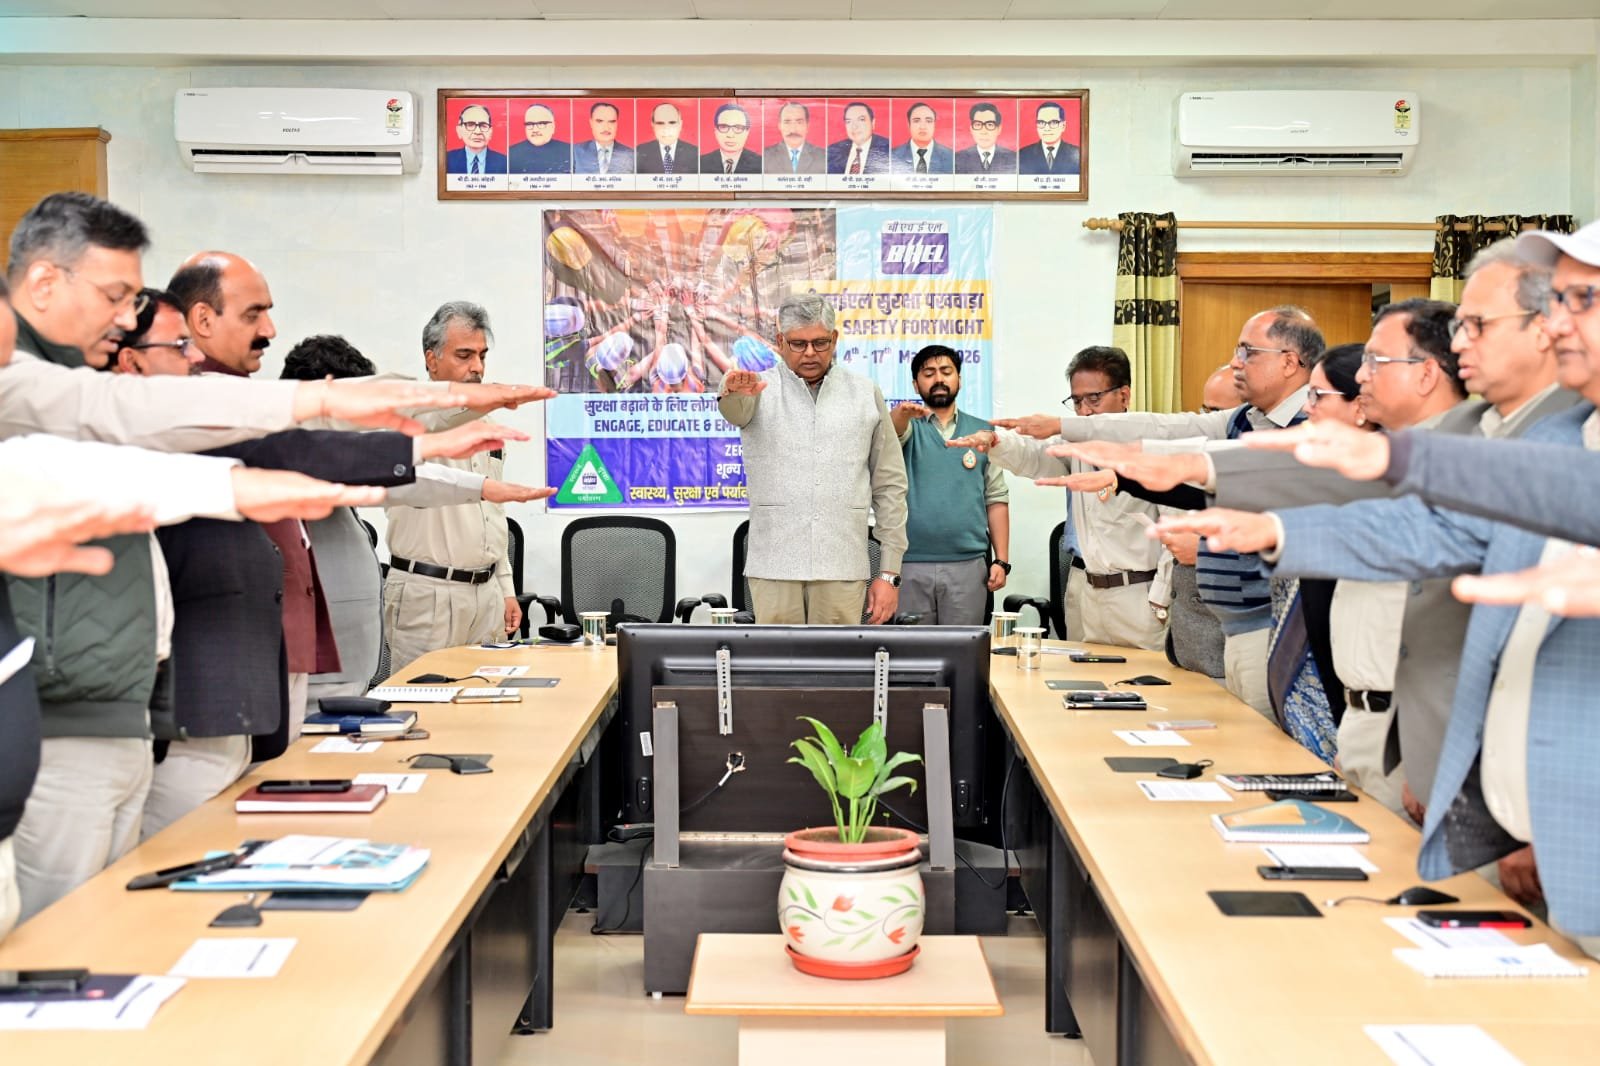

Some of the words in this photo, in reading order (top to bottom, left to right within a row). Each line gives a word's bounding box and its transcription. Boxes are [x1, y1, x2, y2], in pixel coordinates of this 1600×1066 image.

[886, 237, 945, 270] BHEL
[876, 293, 922, 315] सुरक्षा
[925, 293, 985, 313] पखवाड़ा
[842, 319, 898, 335] SAFETY
[901, 319, 985, 335] FORTNIGHT
[584, 400, 618, 417] सुरक्षा
[620, 397, 650, 415] बढ़ाने
[651, 396, 664, 412] के
[665, 396, 689, 412] लिए
[594, 419, 645, 434] ENGAGE,
[647, 419, 701, 432] EDUCATE
[703, 419, 712, 432] &
[725, 444, 744, 457] ZER
[716, 463, 742, 480] शून्य
[673, 486, 703, 506] सुरक्षा
[703, 482, 721, 500] एवं
